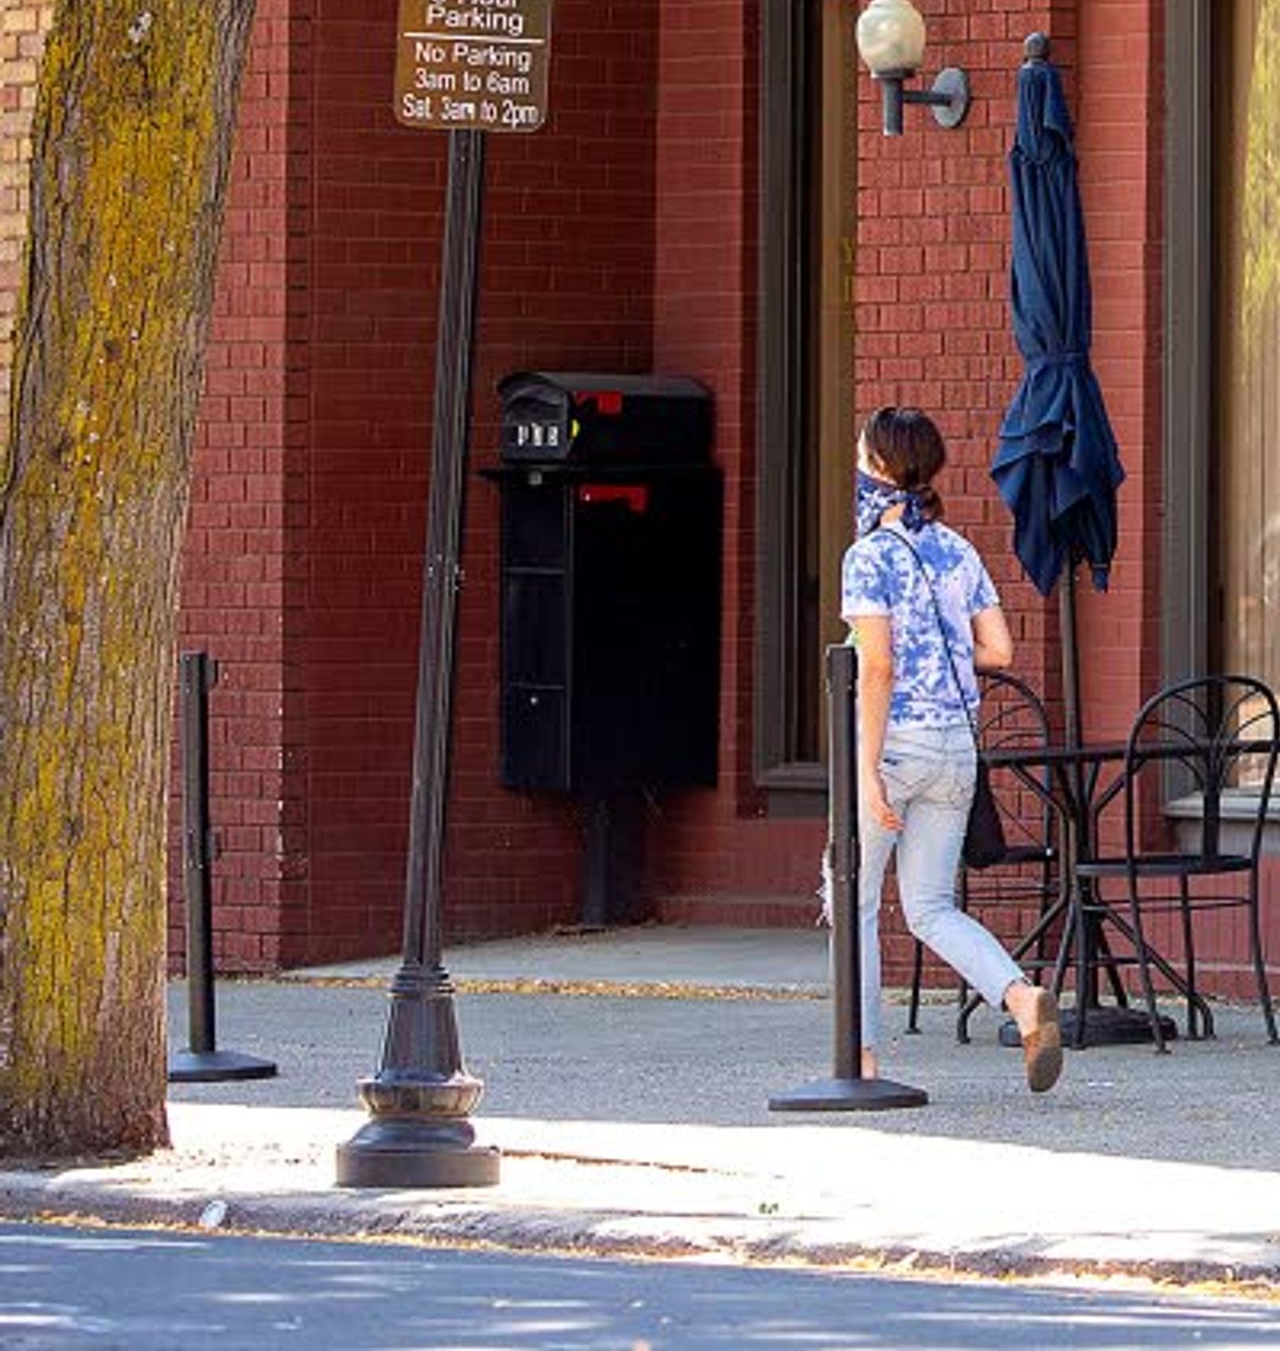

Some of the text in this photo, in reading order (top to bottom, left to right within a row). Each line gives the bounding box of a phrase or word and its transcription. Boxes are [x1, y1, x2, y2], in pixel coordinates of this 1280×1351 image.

[426, 4, 523, 36] Parking
[415, 42, 531, 72] No Parking
[415, 68, 530, 94] 3am to 6am
[480, 100, 497, 122] to
[502, 100, 538, 128] 2pm
